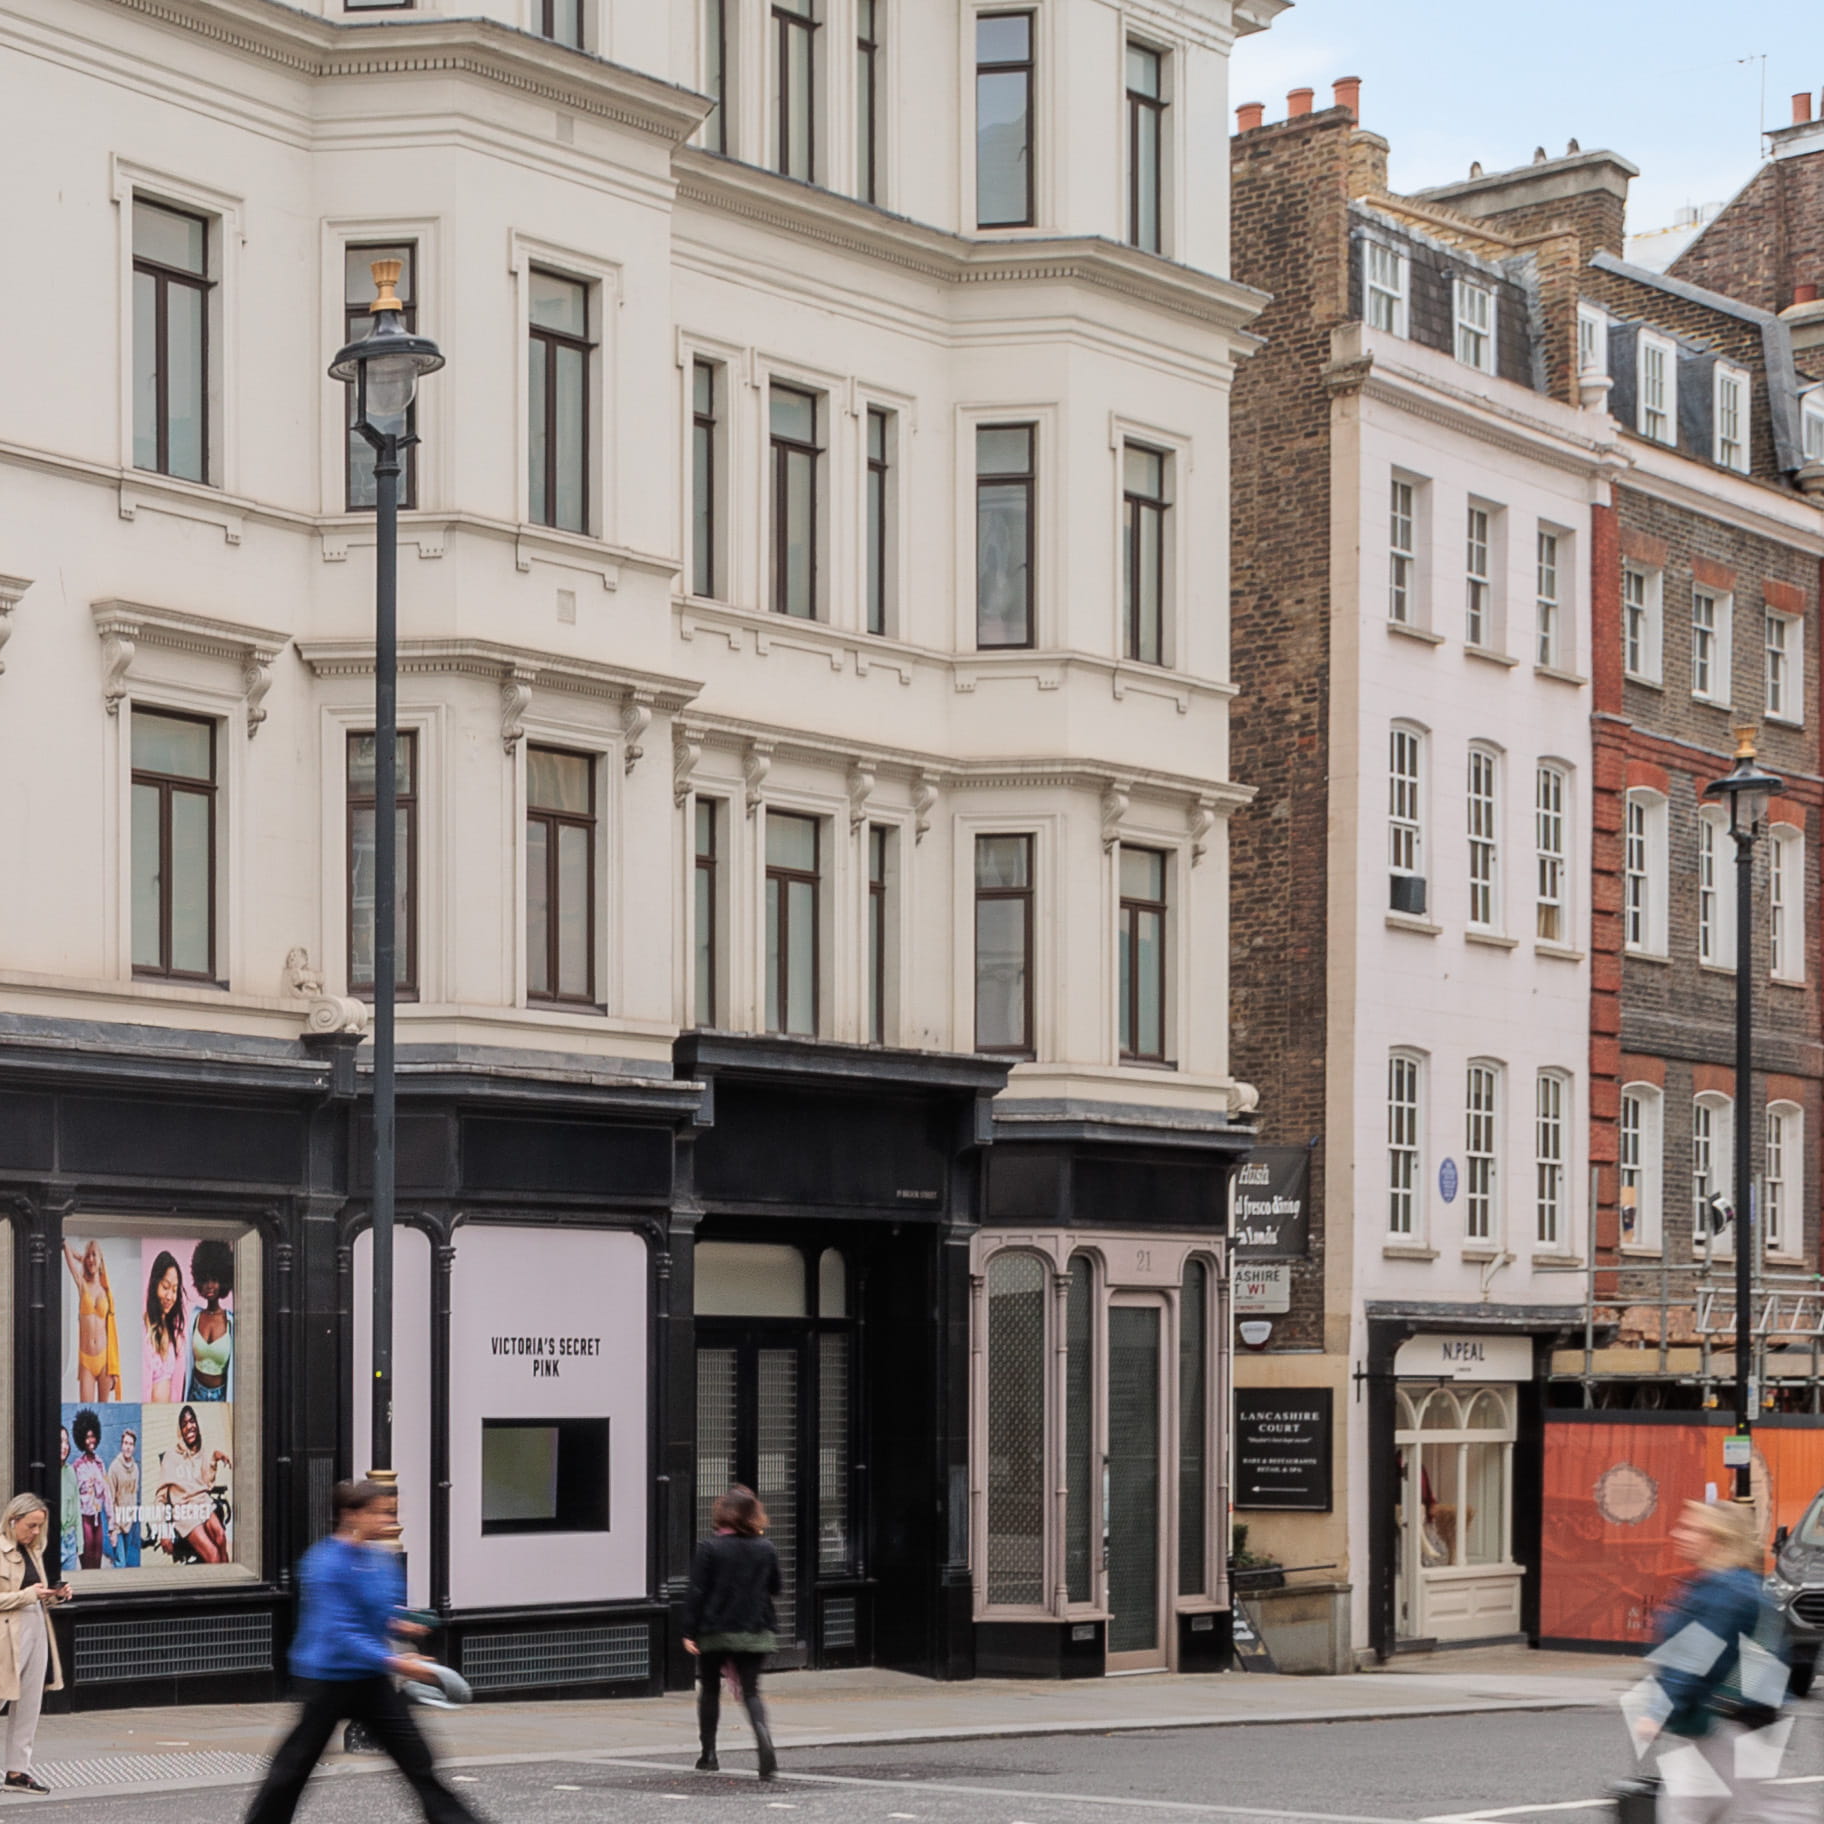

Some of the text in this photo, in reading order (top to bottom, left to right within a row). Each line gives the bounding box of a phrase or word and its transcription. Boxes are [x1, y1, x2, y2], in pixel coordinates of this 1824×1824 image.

[1238, 1163, 1270, 1185] Hush
[1242, 1194, 1272, 1221] fresco
[1272, 1194, 1302, 1219] dining
[1136, 1248, 1152, 1273] 21
[1234, 1269, 1281, 1282] ASHIRE
[1247, 1283, 1266, 1295] W1
[491, 1336, 601, 1356] VICTORIA'S SECRET
[1441, 1341, 1486, 1362] N.PEAL
[533, 1358, 560, 1377] PINK
[1239, 1411, 1320, 1421] LANCASHIRE
[1258, 1423, 1301, 1433] COURT
